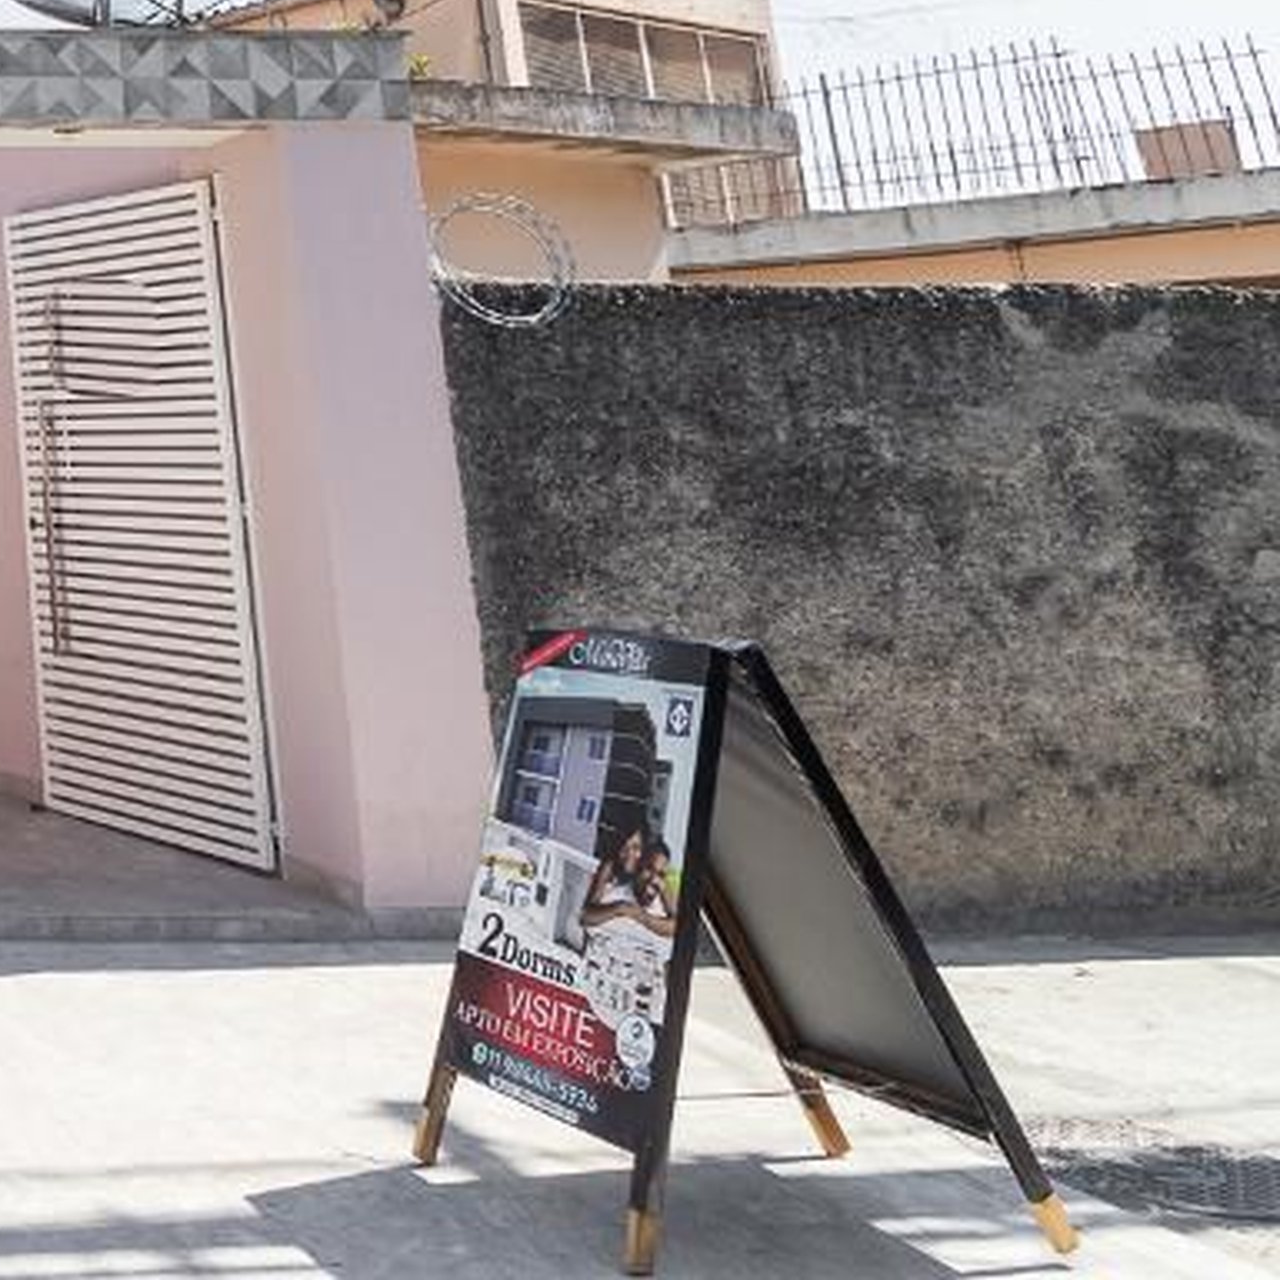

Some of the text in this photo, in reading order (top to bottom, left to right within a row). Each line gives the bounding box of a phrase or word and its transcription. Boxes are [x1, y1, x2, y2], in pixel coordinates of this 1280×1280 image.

[478, 912, 578, 987] 2 Dorms
[506, 982, 595, 1048] VISITE
